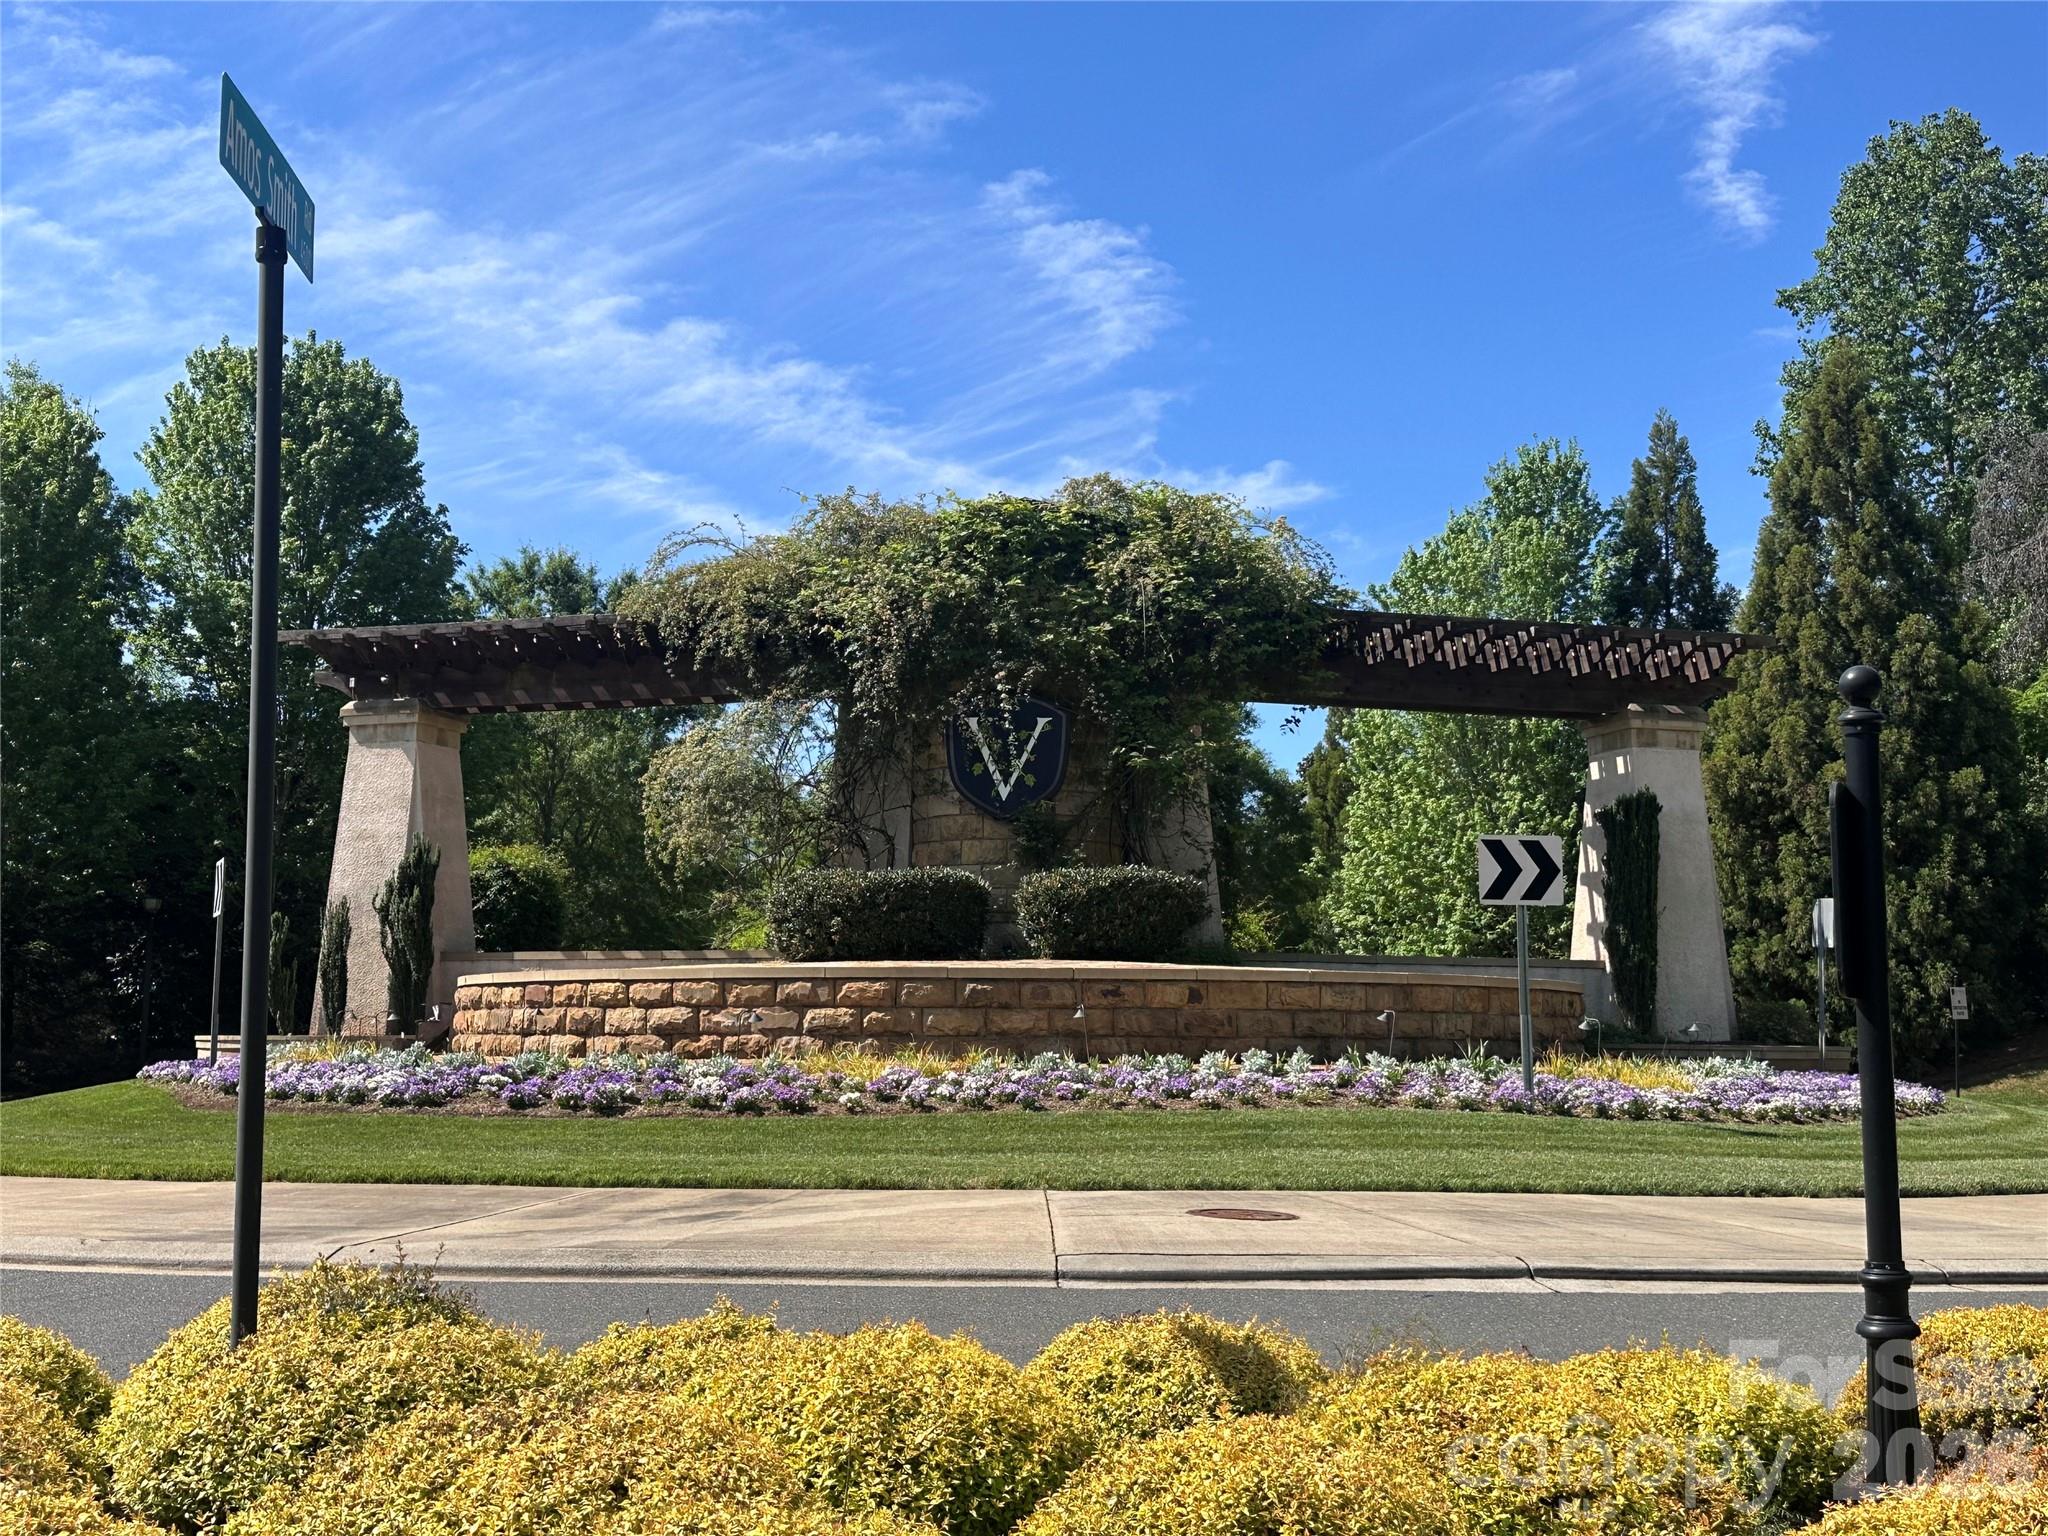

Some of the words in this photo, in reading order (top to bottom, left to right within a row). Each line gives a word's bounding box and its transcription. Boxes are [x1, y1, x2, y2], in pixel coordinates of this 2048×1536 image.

[225, 99, 261, 199] Amos
[267, 155, 297, 250] Smith
[964, 717, 1053, 801] V
